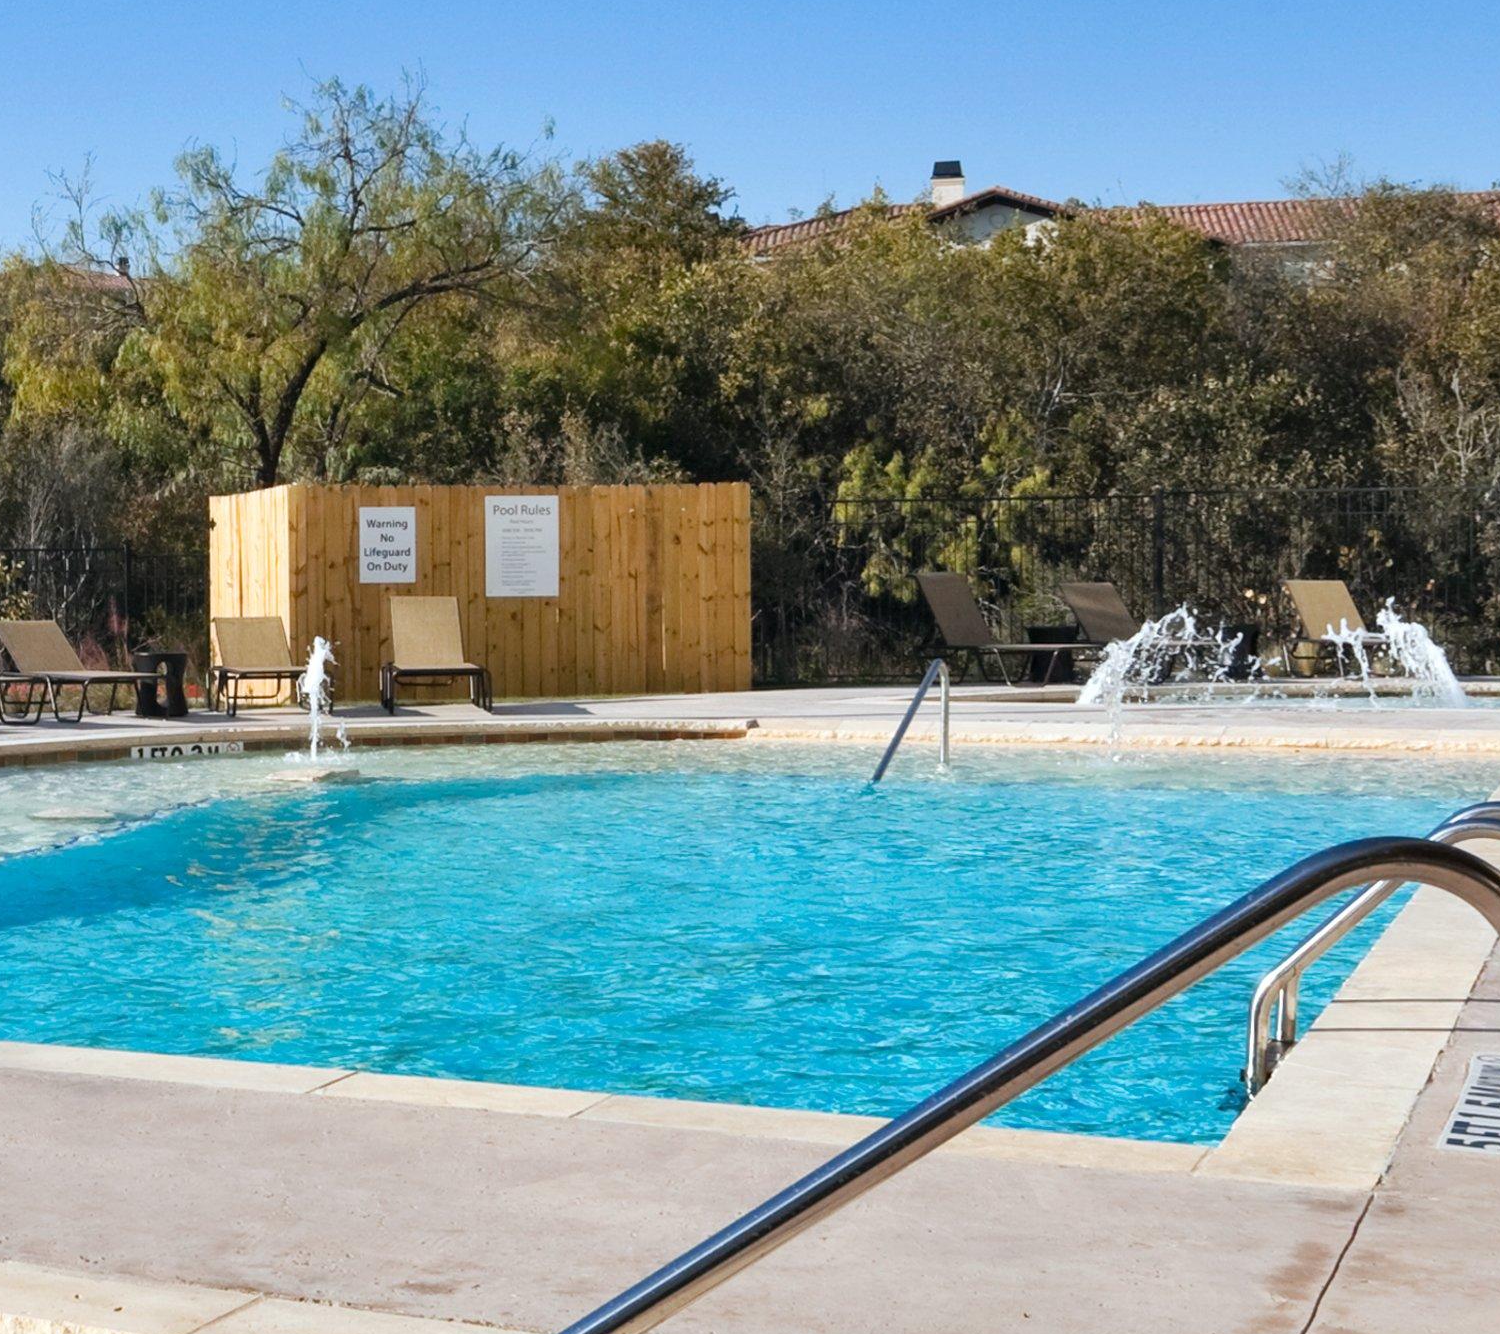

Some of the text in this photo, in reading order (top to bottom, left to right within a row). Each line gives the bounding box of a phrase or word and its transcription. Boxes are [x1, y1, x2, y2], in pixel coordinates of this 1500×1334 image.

[493, 504, 551, 516] Pool Rules
[366, 519, 408, 530] Warning
[380, 533, 394, 543] No
[364, 547, 411, 559] Lifeguard
[367, 562, 408, 573] On Duty
